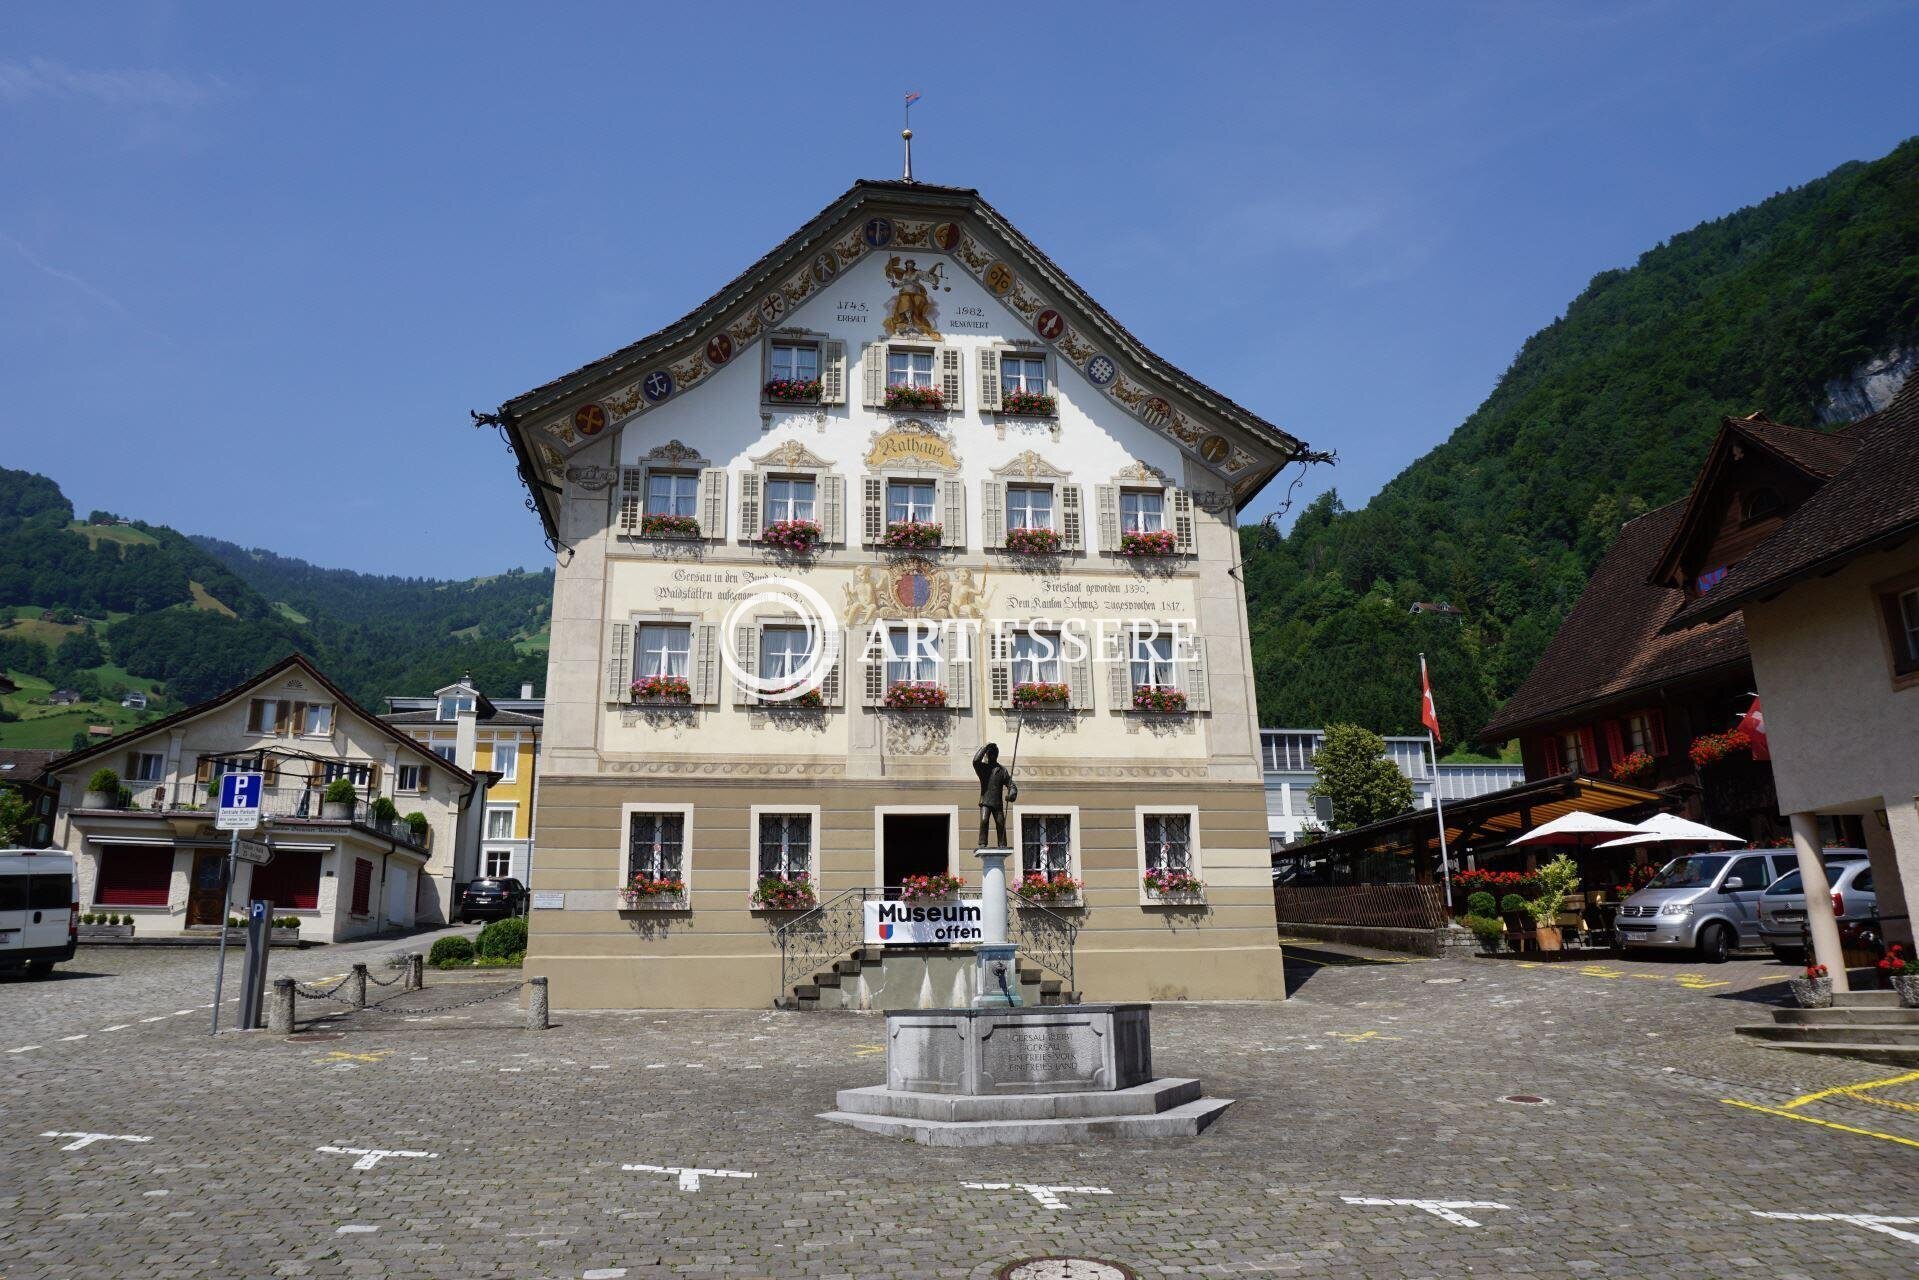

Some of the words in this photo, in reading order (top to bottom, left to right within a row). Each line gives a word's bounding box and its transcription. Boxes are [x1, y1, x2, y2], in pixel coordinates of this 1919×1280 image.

[950, 320, 989, 329] RENOVIERT
[878, 437, 945, 458] Rathaus
[714, 574, 722, 583] in
[725, 570, 738, 584] den
[656, 587, 713, 602] Waldstätten
[1041, 580, 1082, 593] Freistaat
[1085, 582, 1120, 596] geworden
[1007, 597, 1030, 609] Dem
[1031, 597, 1062, 611] Kanton
[1063, 597, 1099, 611] Schwyz
[234, 776, 248, 795] P
[253, 903, 264, 917] P
[879, 904, 981, 923] Museum
[935, 925, 982, 939] offen
[1012, 1034, 1045, 1042] GERSAU
[1026, 1043, 1060, 1052] GERSAU
[1055, 1062, 1078, 1071] LAND
